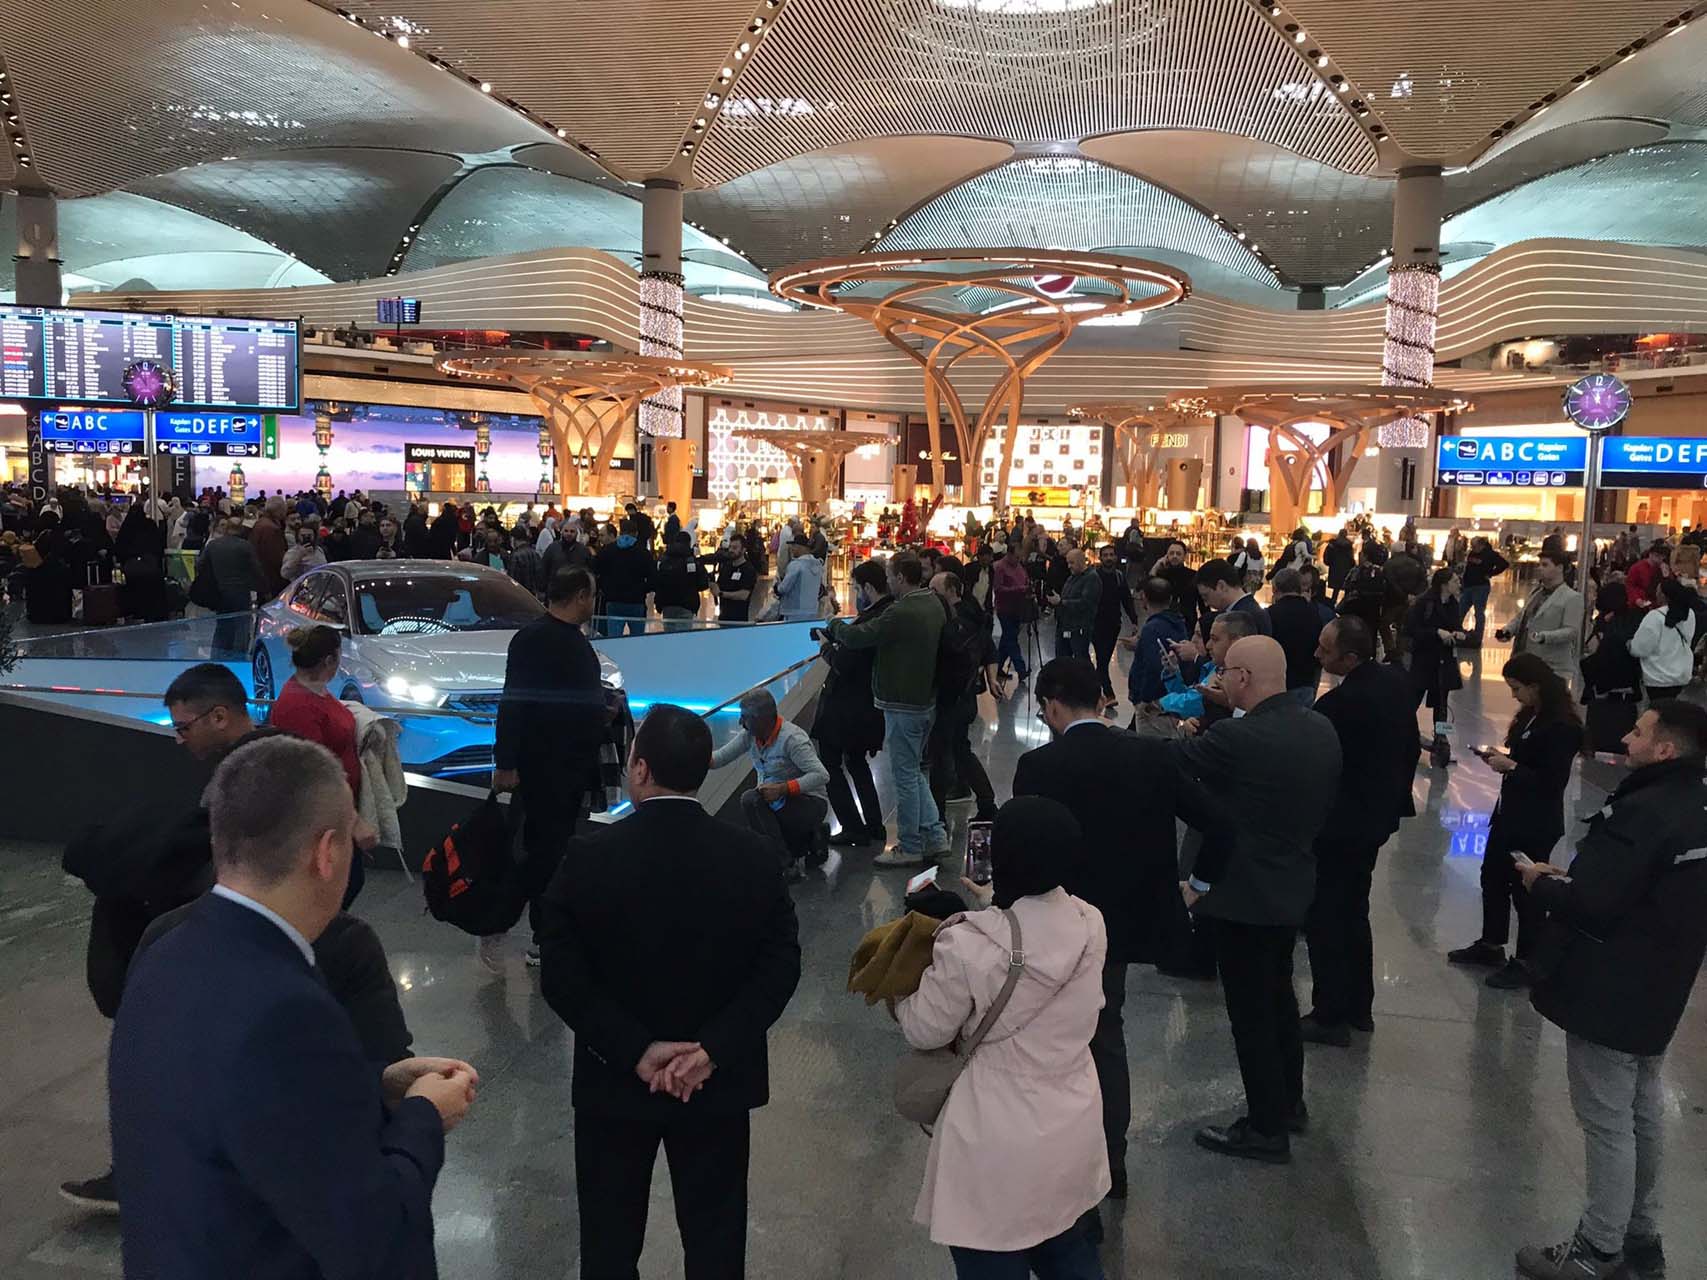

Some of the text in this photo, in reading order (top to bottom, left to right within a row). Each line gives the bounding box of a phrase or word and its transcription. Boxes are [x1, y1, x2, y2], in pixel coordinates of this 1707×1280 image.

[1595, 376, 1603, 386] 12
[411, 448, 471, 459] LOUIS VUITTON
[1537, 453, 1560, 462] Gates
[1629, 453, 1653, 462] Gates
